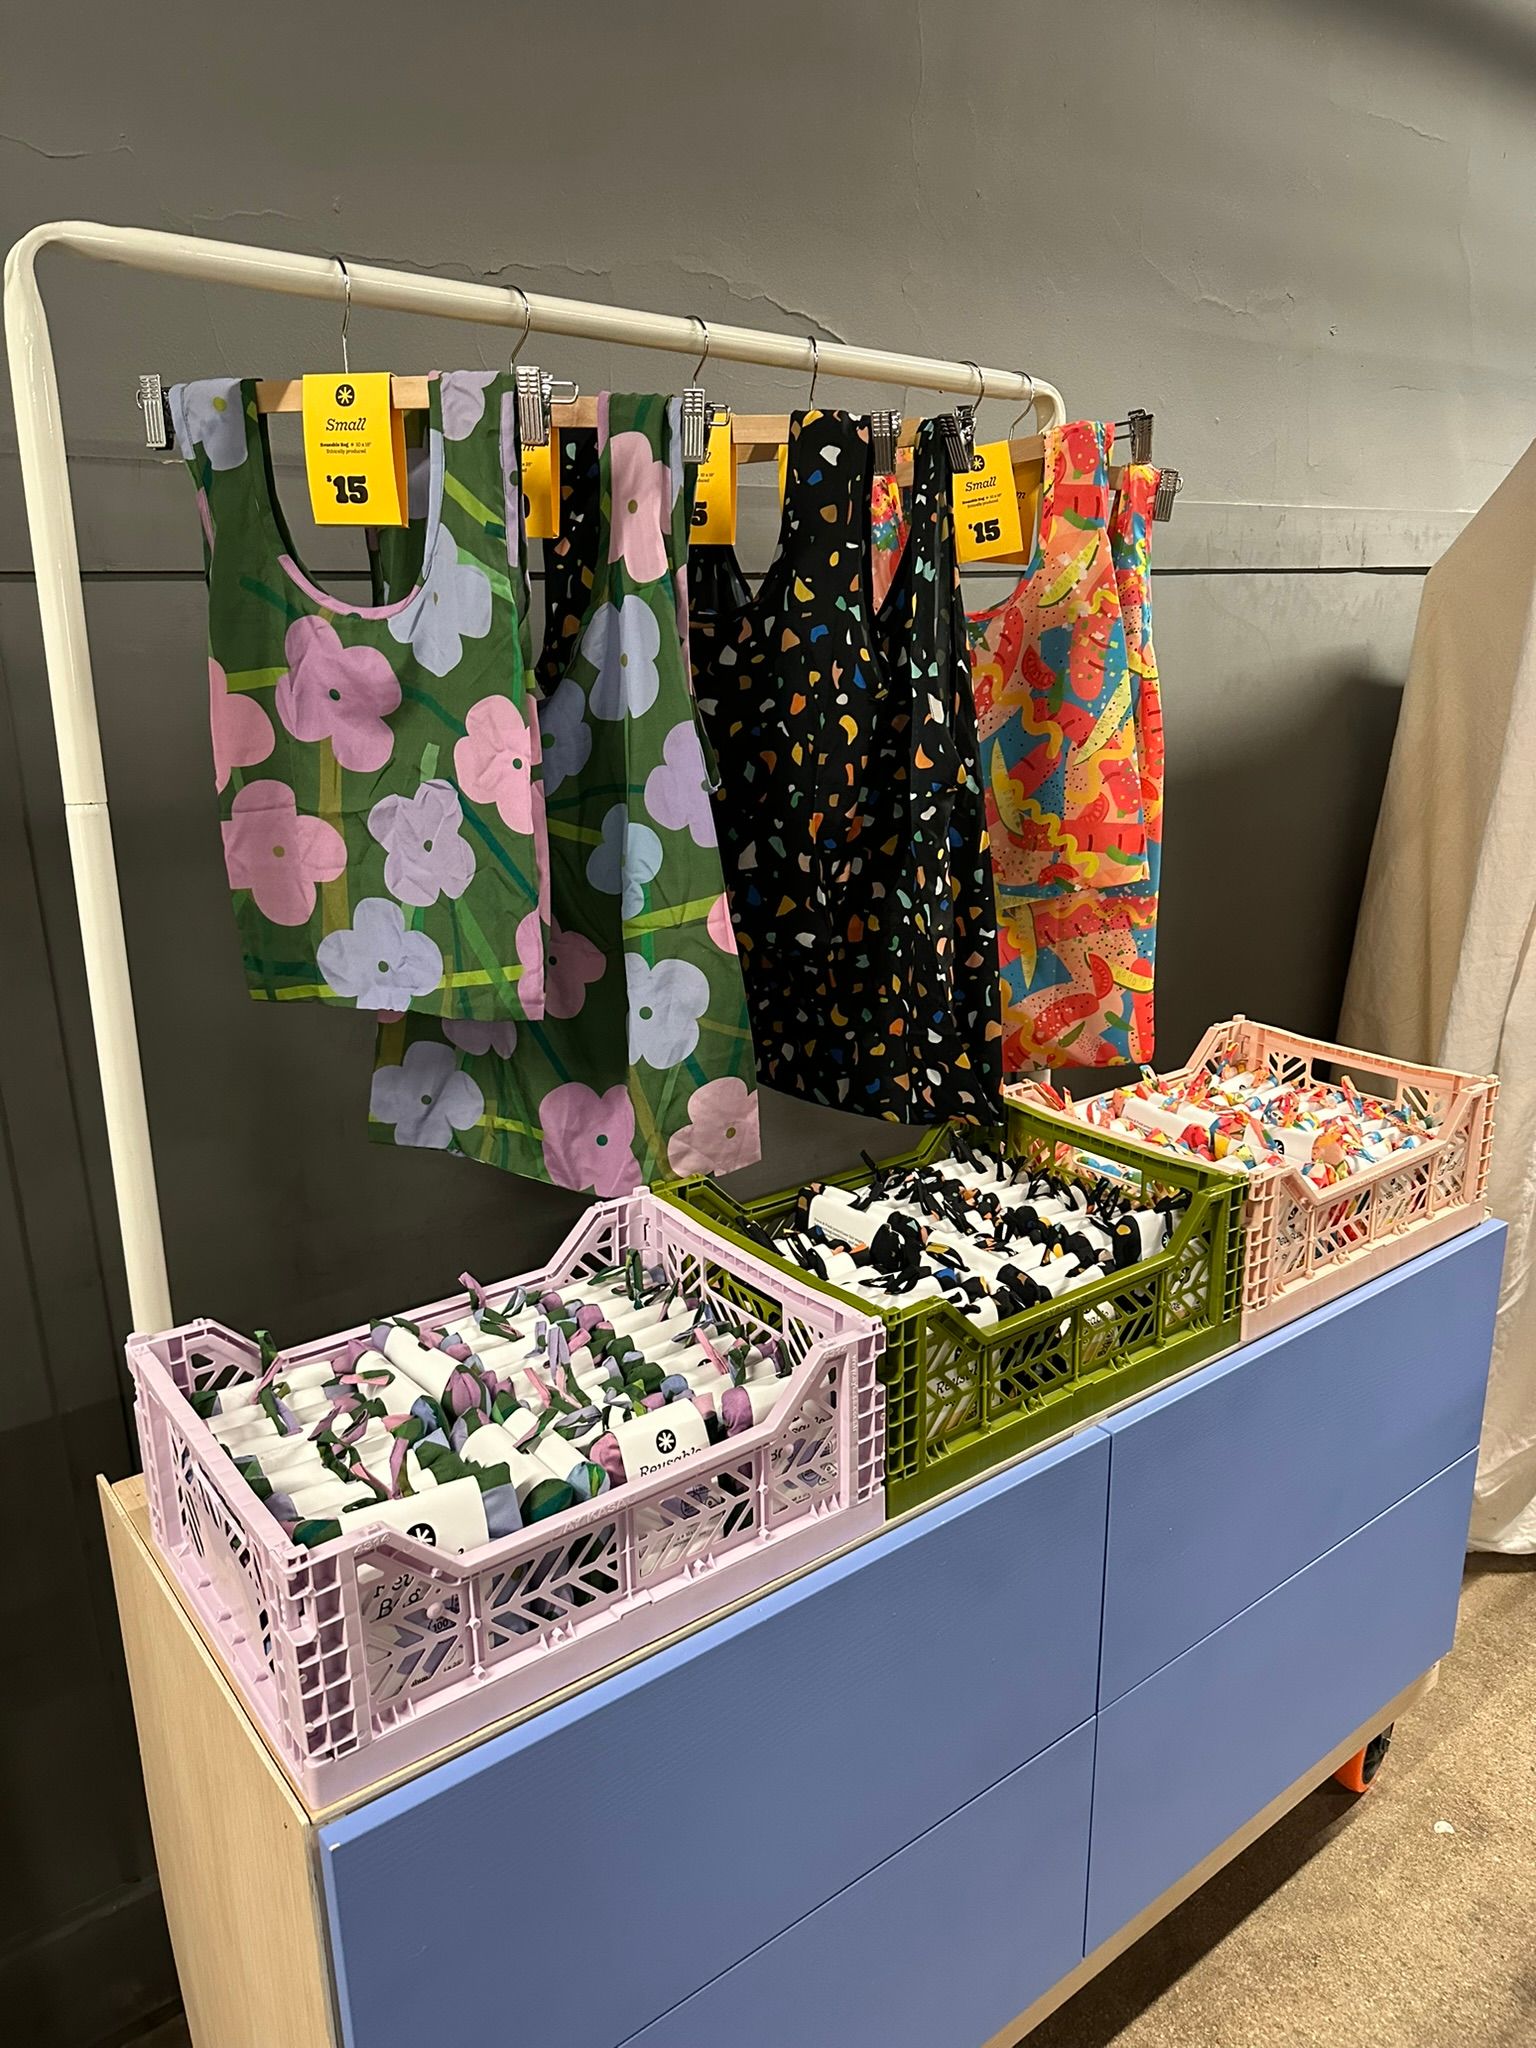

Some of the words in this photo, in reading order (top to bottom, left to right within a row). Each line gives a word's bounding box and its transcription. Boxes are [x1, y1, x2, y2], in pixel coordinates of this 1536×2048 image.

[326, 417, 367, 432] Small
[326, 474, 369, 504] $15
[965, 476, 997, 492] Small
